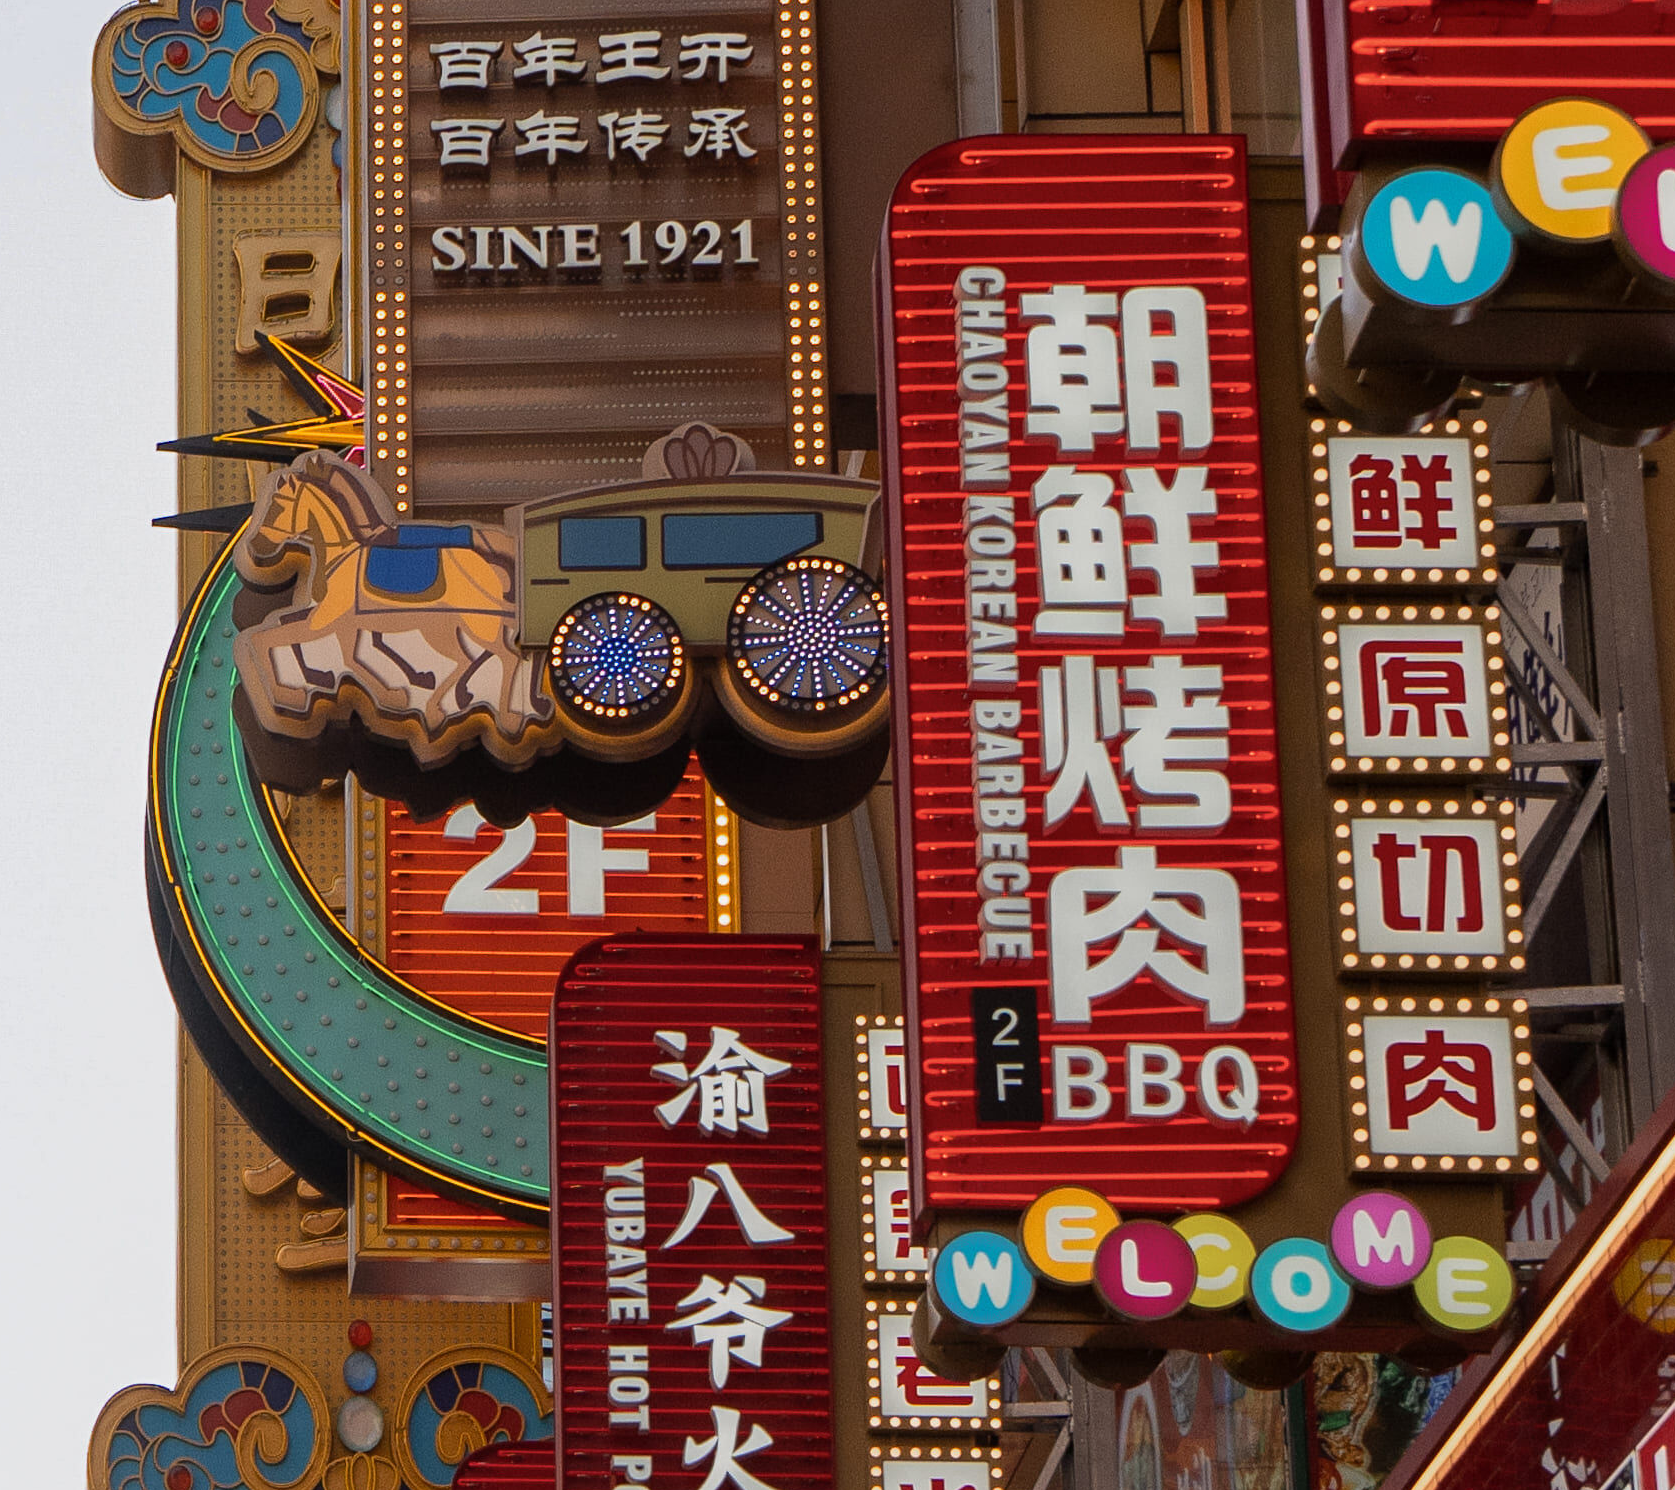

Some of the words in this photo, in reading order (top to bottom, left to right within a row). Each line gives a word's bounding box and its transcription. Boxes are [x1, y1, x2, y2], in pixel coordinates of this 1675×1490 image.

[429, 29, 756, 93] 百年王开
[429, 107, 760, 167] 百年传承
[431, 222, 603, 275] SINE
[619, 217, 762, 268] 1921
[956, 264, 1012, 486] CHAOYAN
[965, 495, 1019, 687] KOREAN
[1018, 283, 1249, 1026] 朝鲜烤肉
[1337, 276, 1498, 1132] 鲜原切肉
[441, 803, 658, 918] 2F
[970, 699, 1034, 963] BARBECUE
[1051, 1042, 1261, 1124] BBQ
[603, 1157, 650, 1324] YUBAYE
[951, 1205, 1492, 1315] WELCOME
[607, 1344, 651, 1432] HOT
